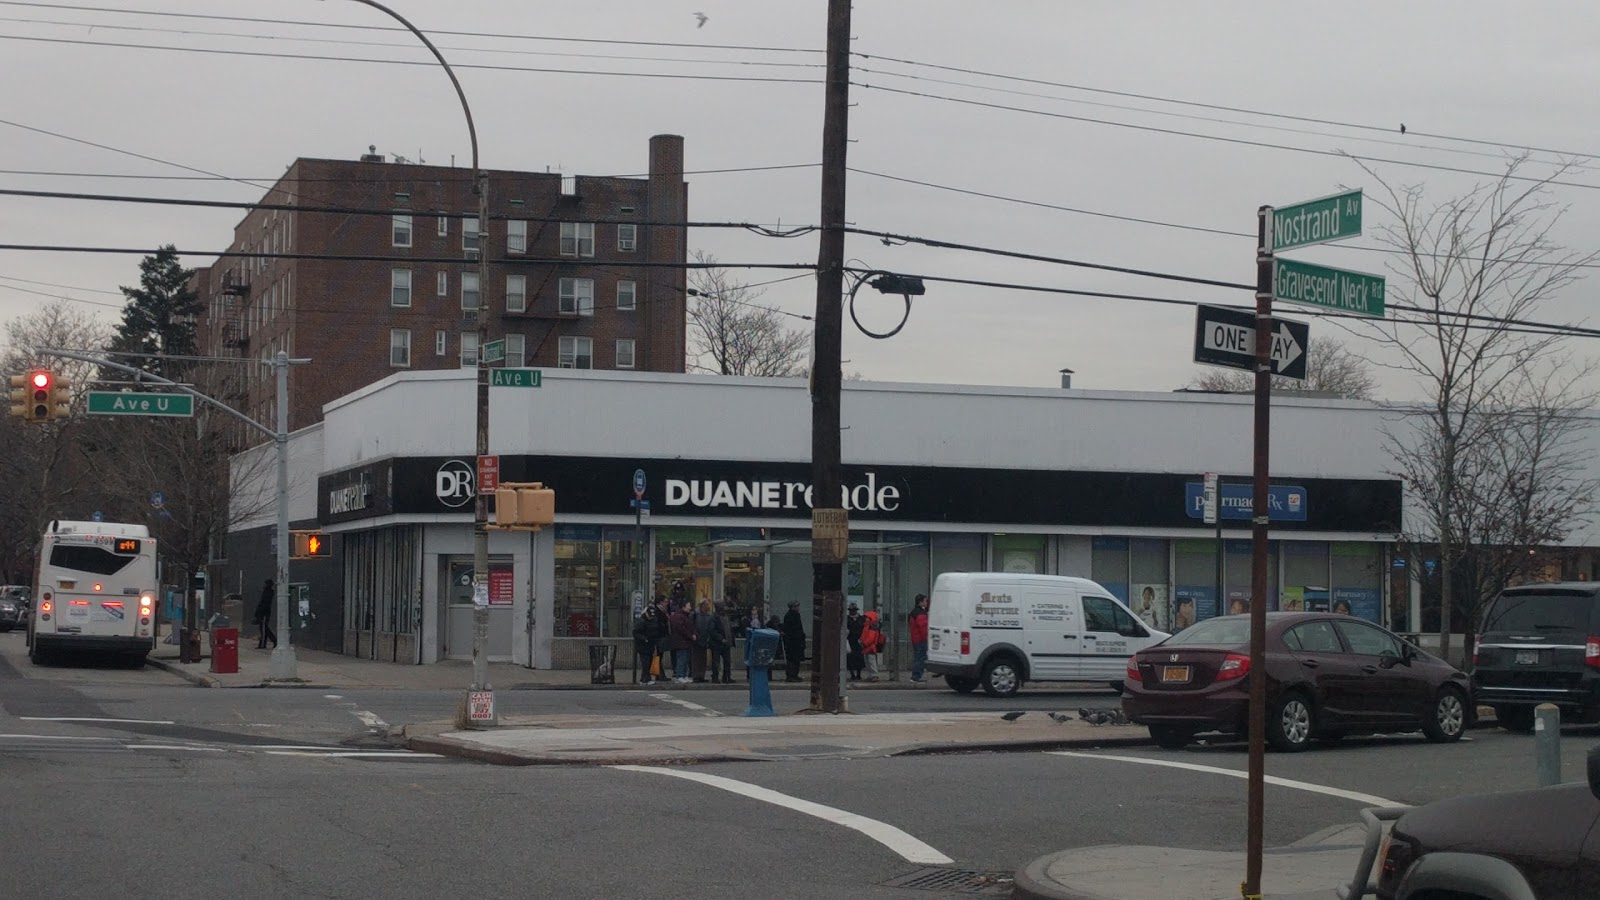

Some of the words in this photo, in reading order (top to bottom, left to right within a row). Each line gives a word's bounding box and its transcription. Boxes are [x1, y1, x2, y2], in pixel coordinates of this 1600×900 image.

[1274, 199, 1340, 247] Nostrand
[1346, 199, 1359, 217] Av
[1277, 264, 1338, 305] Gravesend
[1341, 276, 1368, 311] Neck
[1371, 281, 1382, 299] Rd
[1214, 325, 1248, 352] ONE
[1270, 335, 1293, 360] AY
[494, 370, 522, 386] Ave
[530, 371, 539, 386] U
[113, 397, 150, 411] Ave
[158, 398, 169, 411] U
[436, 470, 475, 497] DR
[813, 511, 847, 523] LUTHERAN
[974, 603, 1020, 617] Supreme
